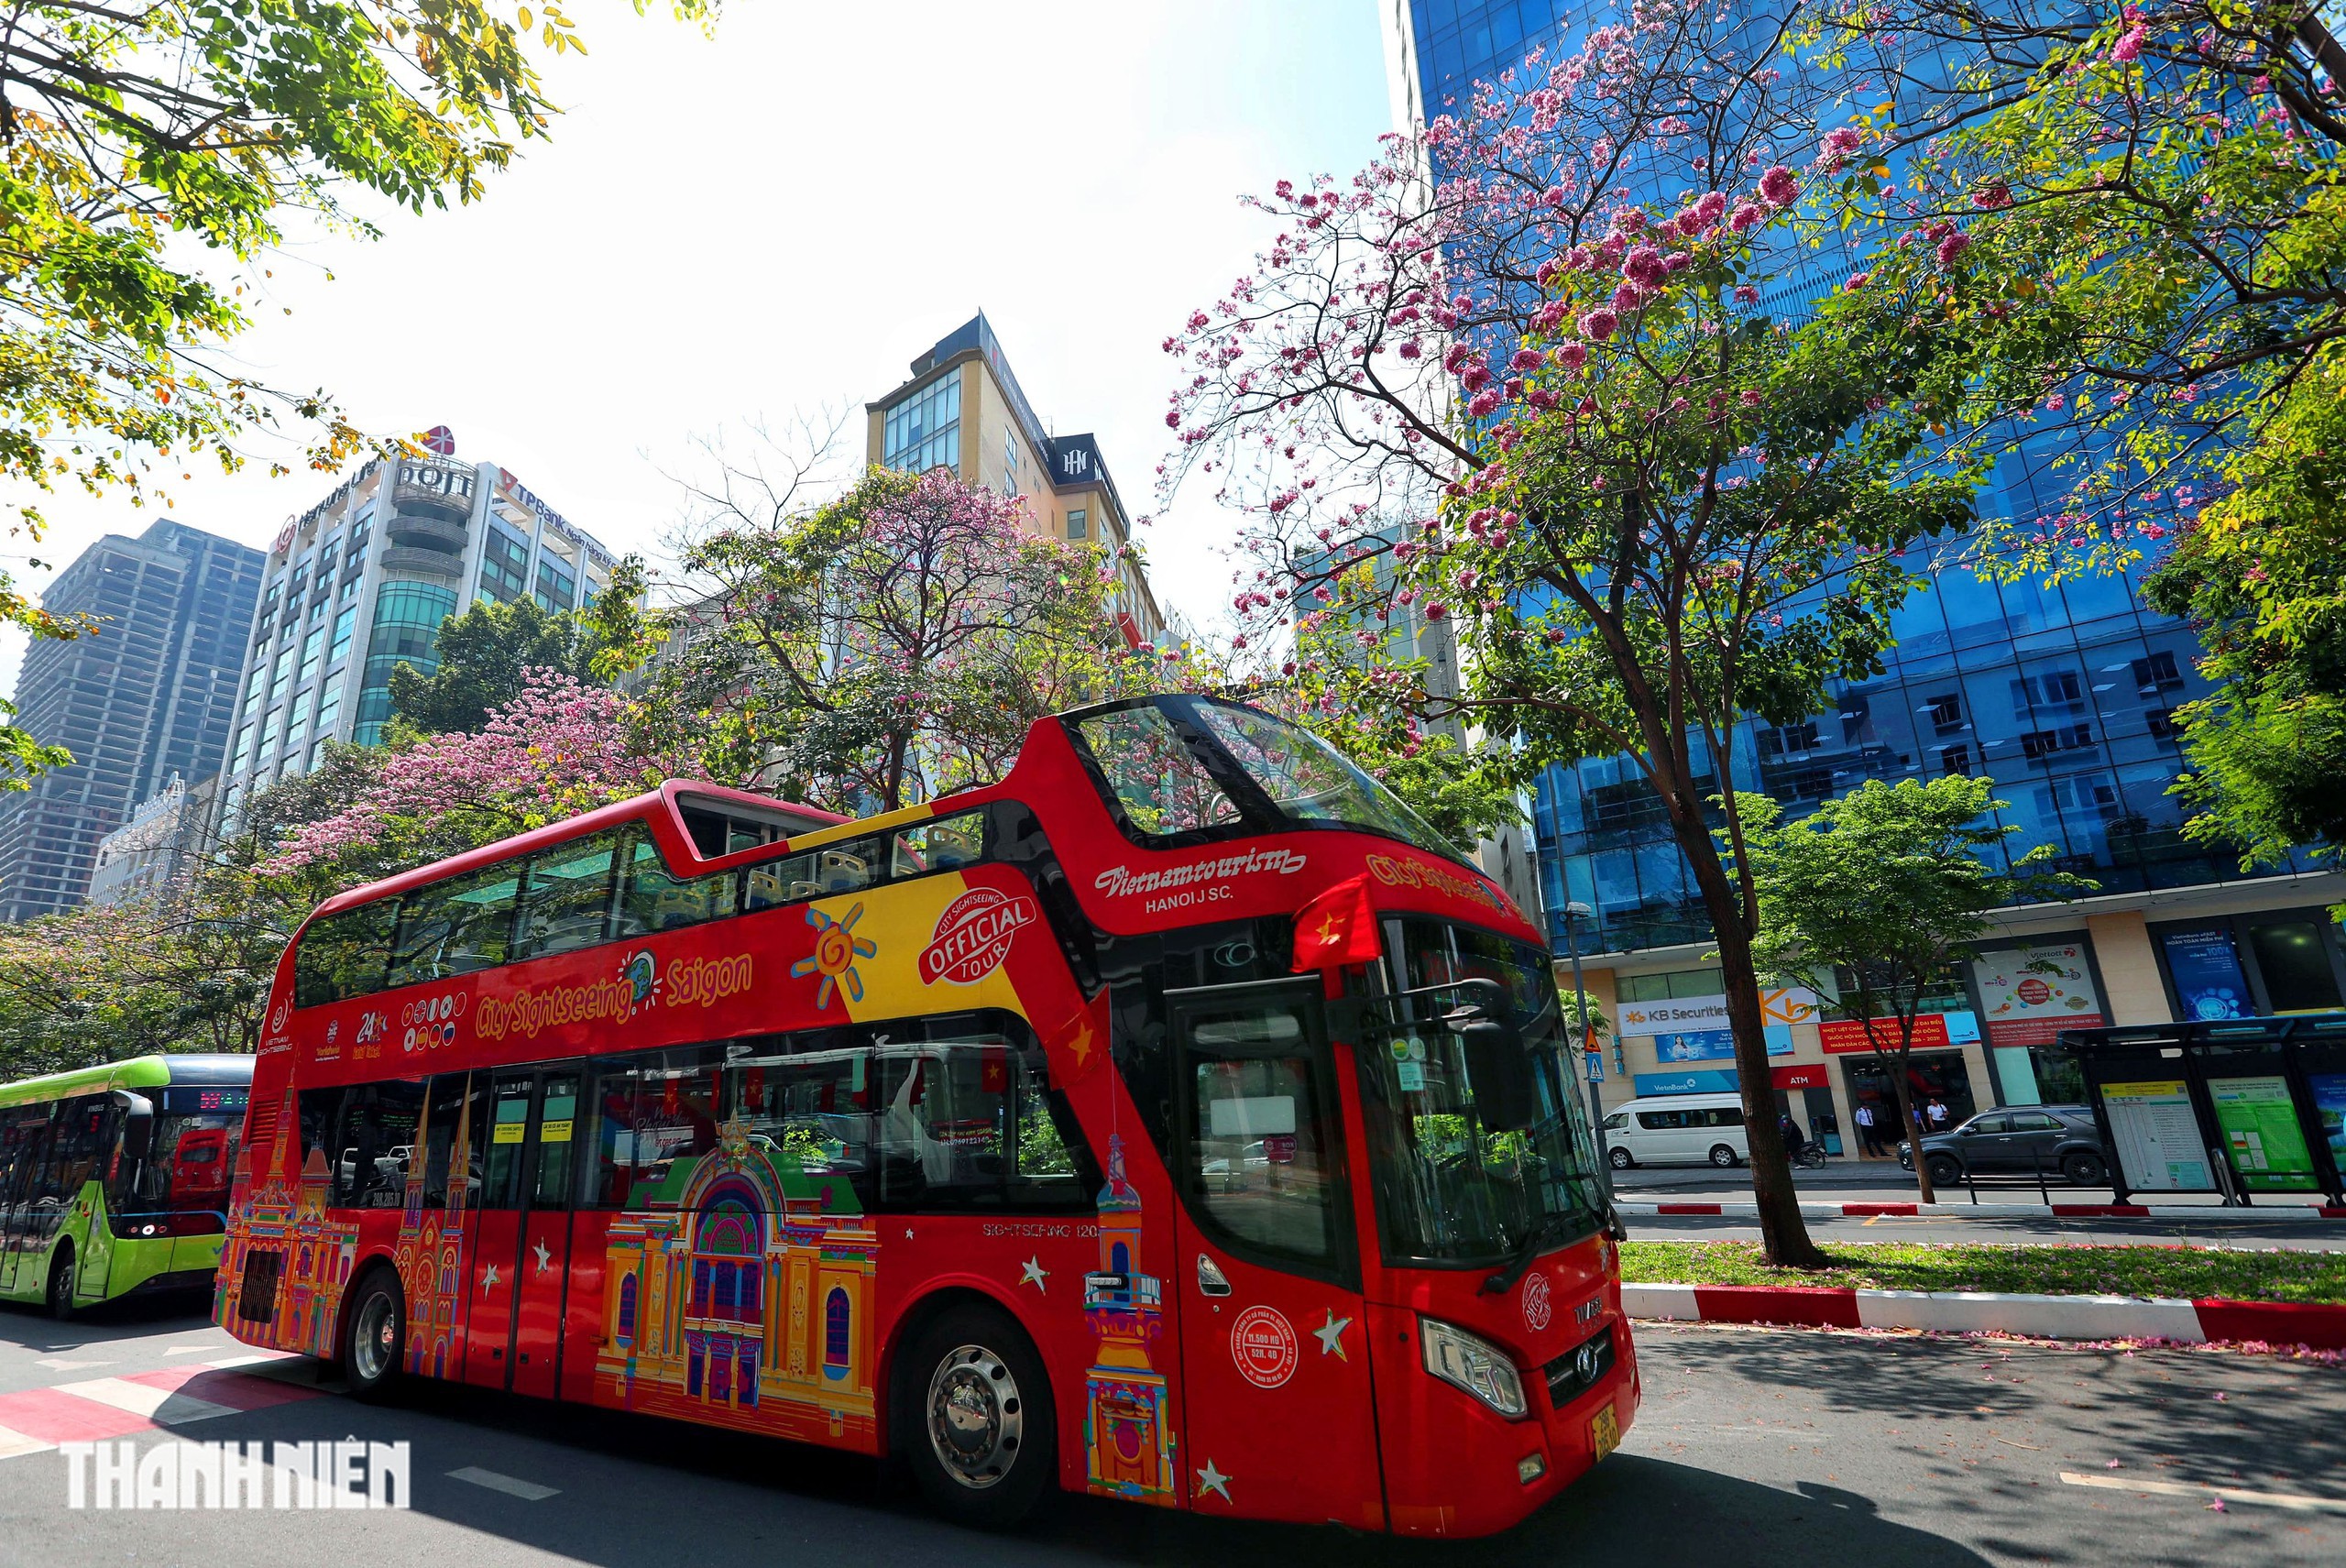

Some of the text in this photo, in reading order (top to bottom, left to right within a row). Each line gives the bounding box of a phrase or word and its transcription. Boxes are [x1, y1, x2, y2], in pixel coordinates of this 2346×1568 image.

[396, 466, 474, 499] DOJI
[518, 483, 566, 533] TPBank
[565, 527, 585, 547] Ngân
[585, 541, 602, 561] hàng
[1095, 847, 1307, 898] Vietnamtourism
[1365, 854, 1421, 889] City
[939, 894, 1000, 935] CITY SIGHTSEEING
[928, 902, 1028, 974] OFFICIAL
[2030, 950, 2063, 960] Vietlott
[961, 942, 1006, 978] TOUR
[666, 953, 752, 1007] Saigon
[476, 978, 633, 1040] City Sightseeing
[1649, 1009, 1670, 1022] KB
[265, 1036, 290, 1047] VIETNAM
[1654, 1082, 1689, 1091] VietinBank
[1790, 1076, 1809, 1085] ATM
[1526, 1280, 1550, 1324] OFFICIAL
[1248, 1333, 1268, 1344] 11.500
